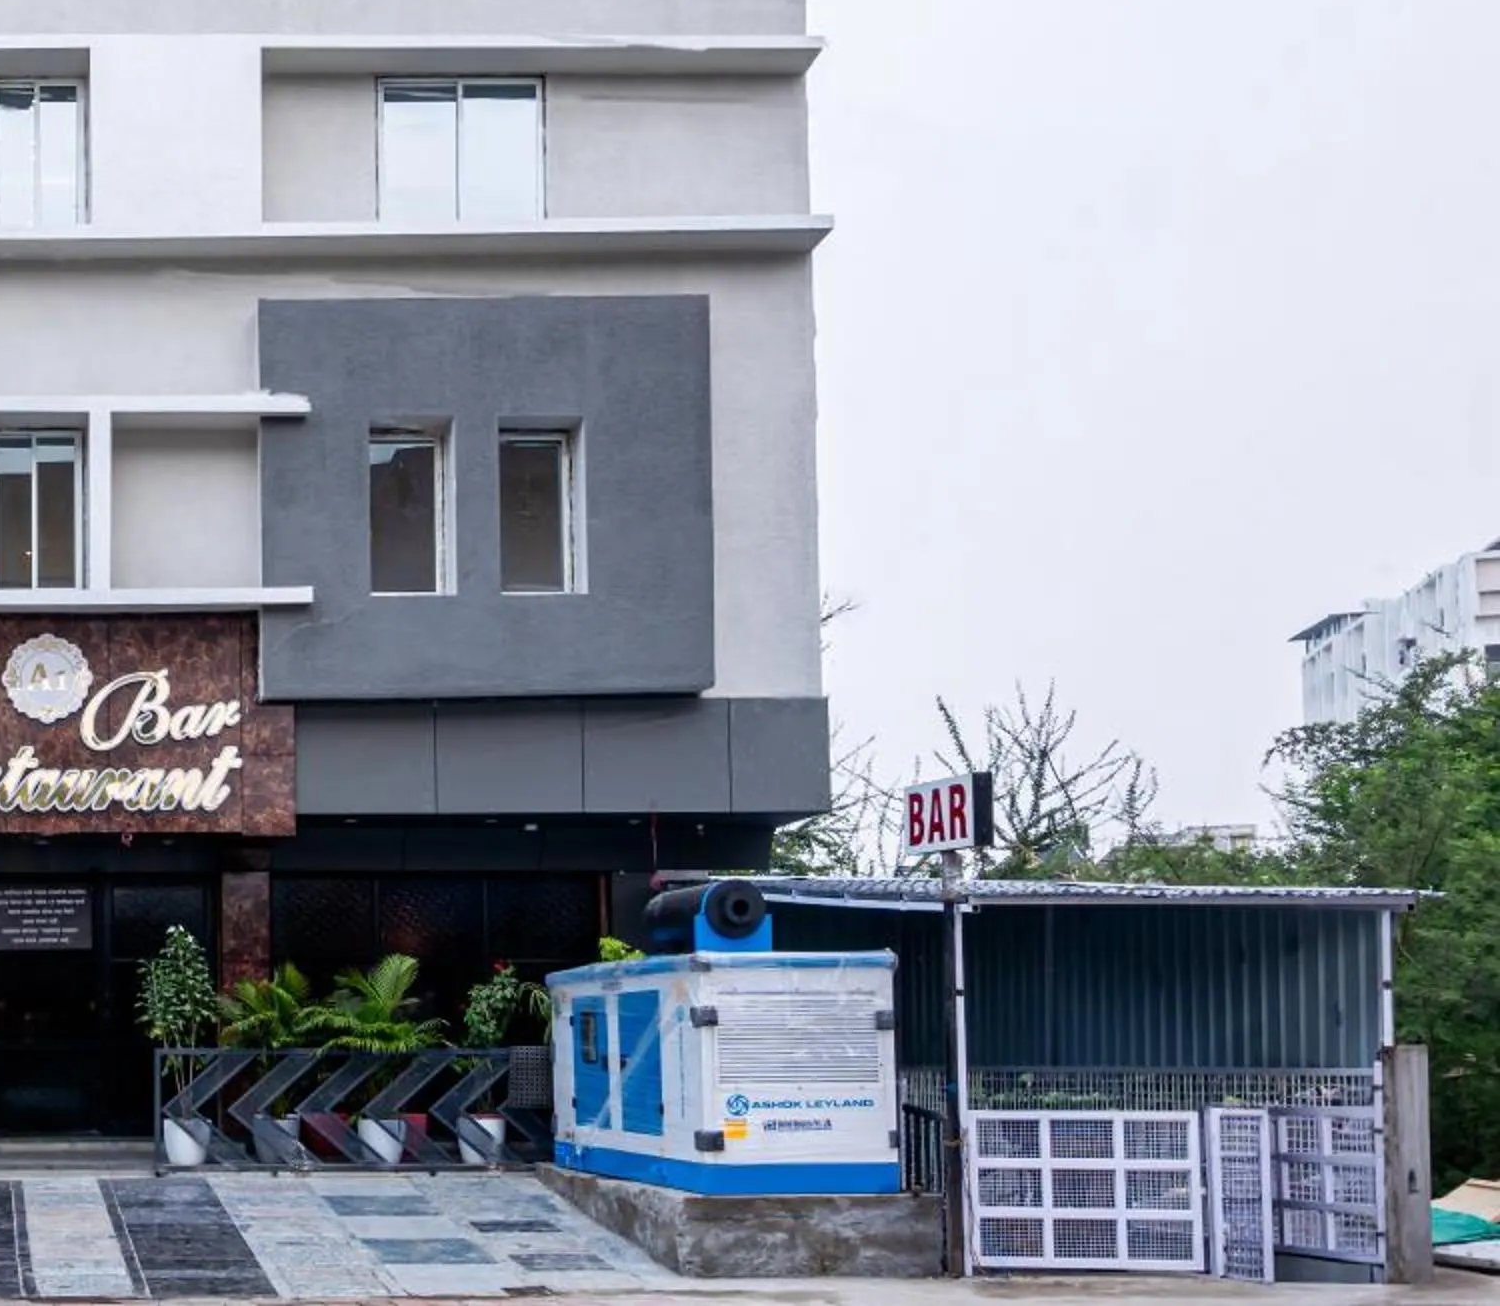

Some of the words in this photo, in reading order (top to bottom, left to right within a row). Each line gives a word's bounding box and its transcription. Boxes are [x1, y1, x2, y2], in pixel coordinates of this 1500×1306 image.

[80, 668, 242, 751] Bar
[908, 783, 968, 846] BAR
[751, 1101, 802, 1109] ASHOK
[805, 1098, 875, 1108] LEYLAND
